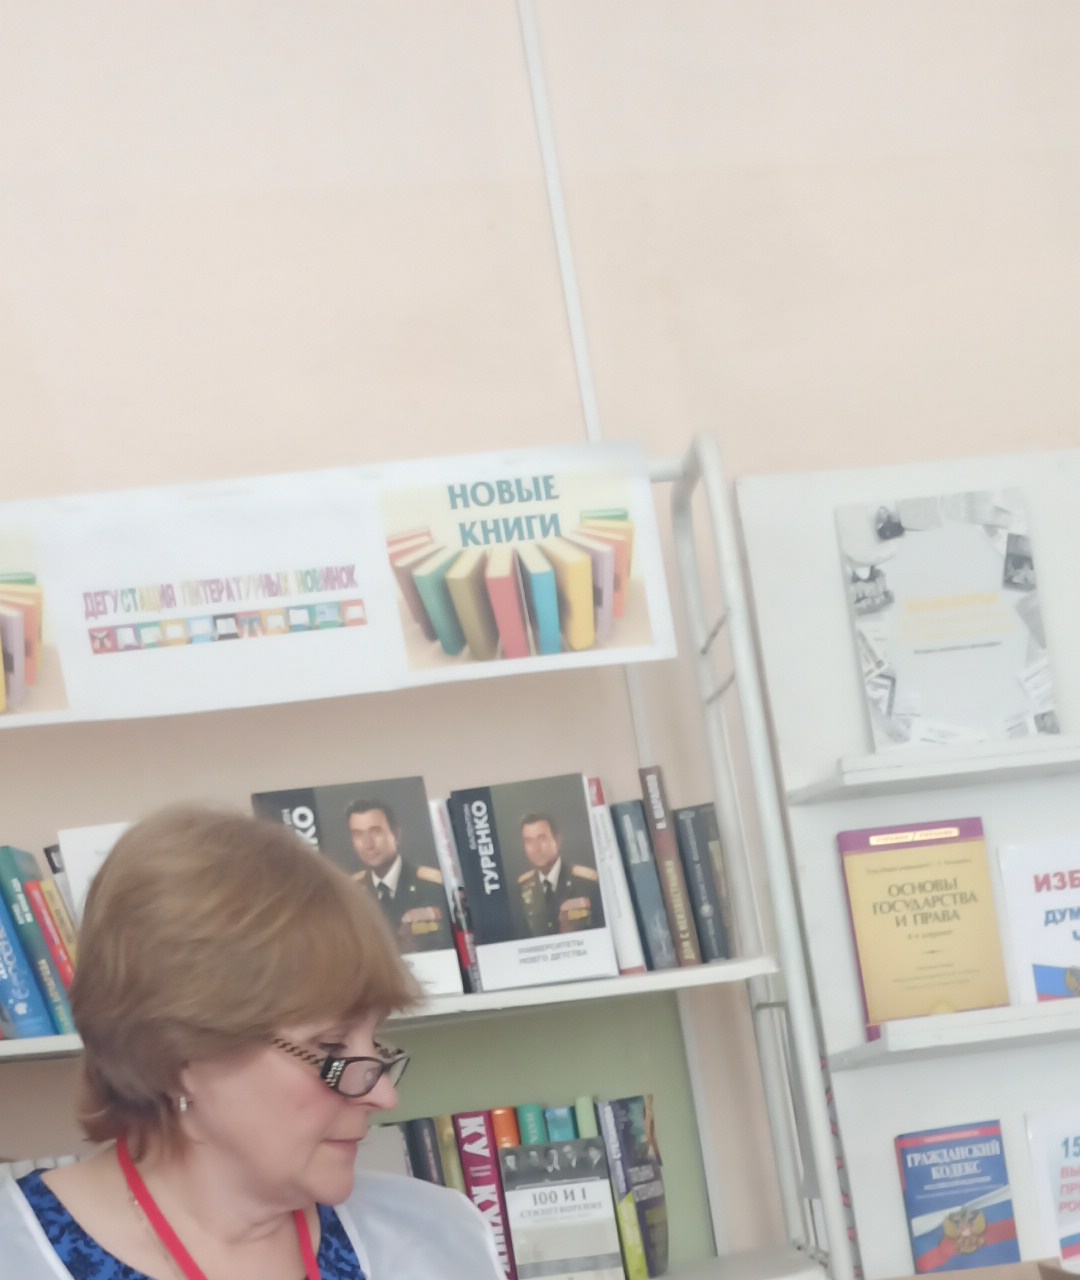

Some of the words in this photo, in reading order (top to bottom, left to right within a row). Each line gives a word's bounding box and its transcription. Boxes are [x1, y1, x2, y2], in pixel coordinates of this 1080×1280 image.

[447, 475, 559, 510] НОВЫЕ
[459, 513, 562, 547] КНИГИ
[471, 801, 501, 895] ТУРЕНКО
[887, 878, 958, 898] ОСНОВЫ
[872, 891, 979, 915] ГОСУДАРСТВА
[895, 914, 907, 928] И
[912, 909, 961, 927] ПРАВА
[906, 1139, 1001, 1168] ГРАЖДАНСКИЙ
